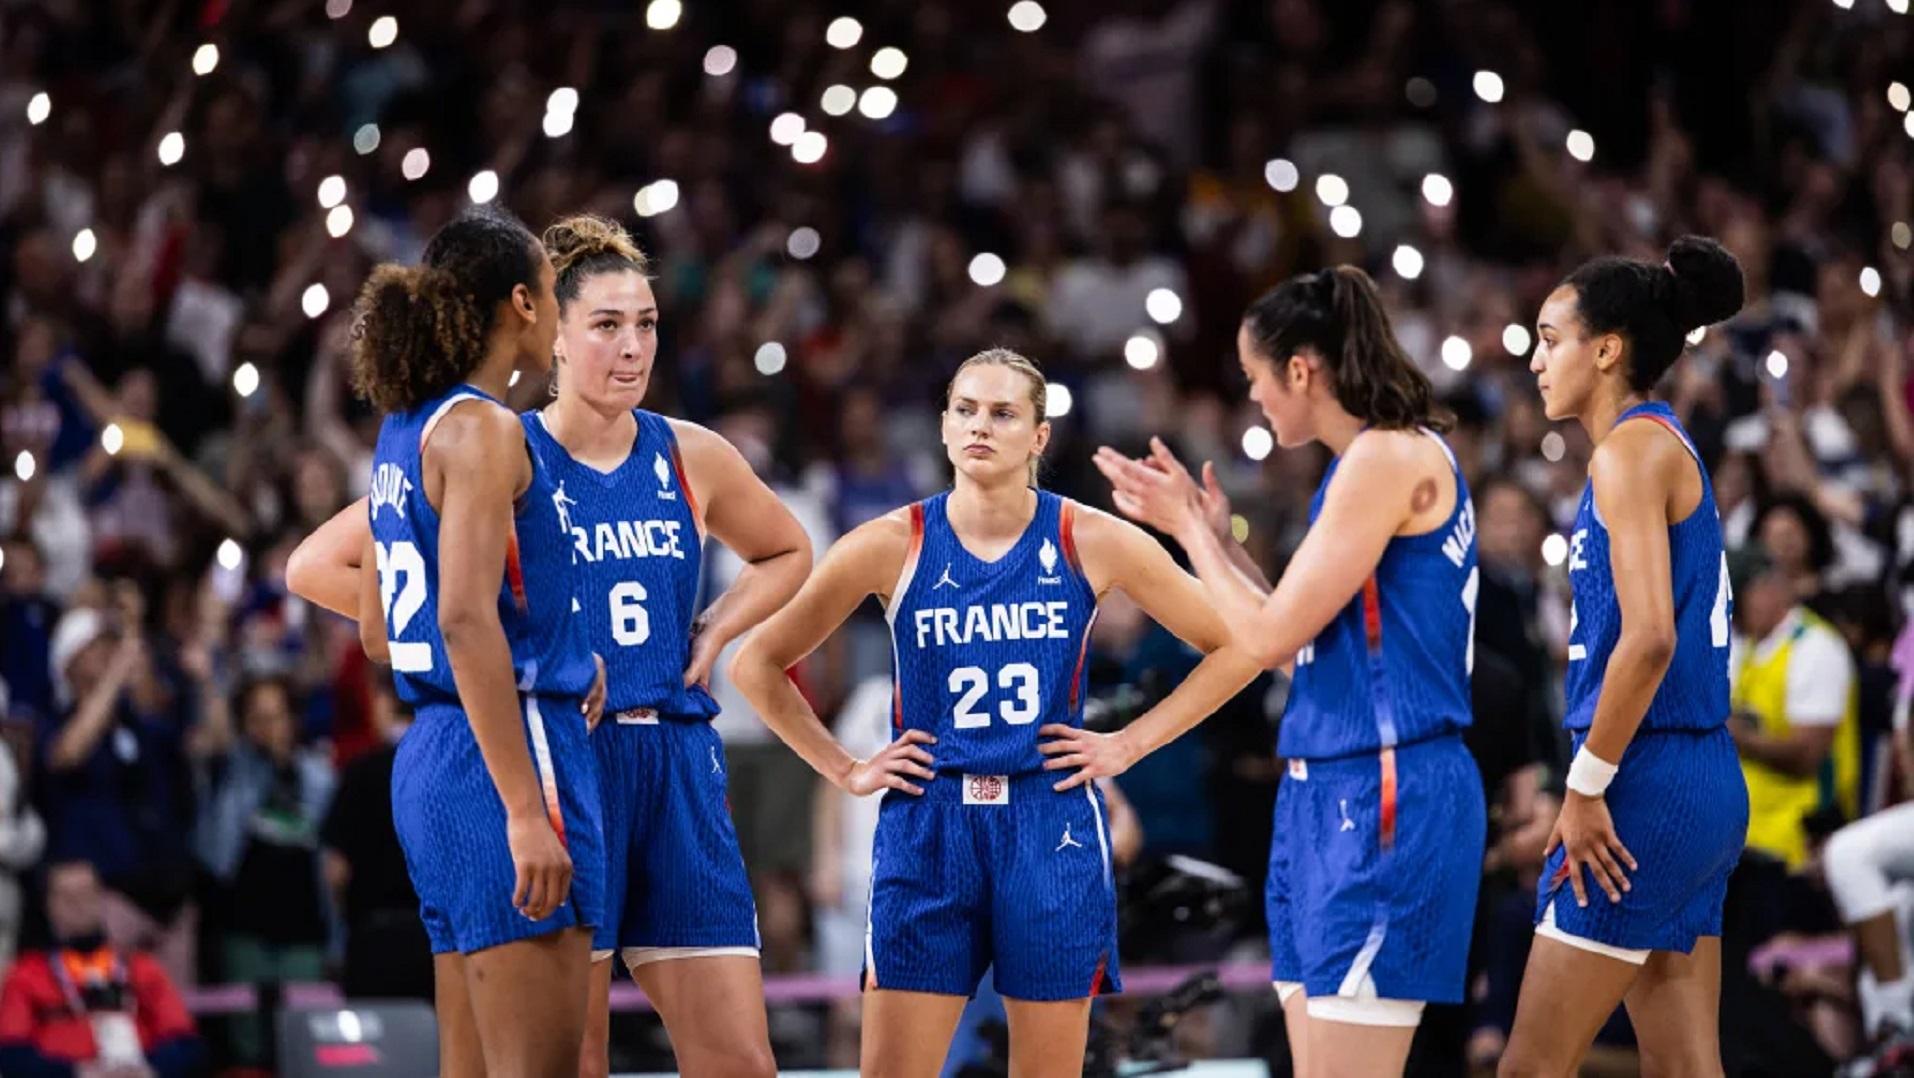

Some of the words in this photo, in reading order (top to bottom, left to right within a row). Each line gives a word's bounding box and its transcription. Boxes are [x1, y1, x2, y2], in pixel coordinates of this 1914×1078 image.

[571, 520, 685, 566] RANCE
[608, 581, 651, 647] 6
[914, 601, 1069, 649] FRANCE
[947, 661, 1041, 729] 23
